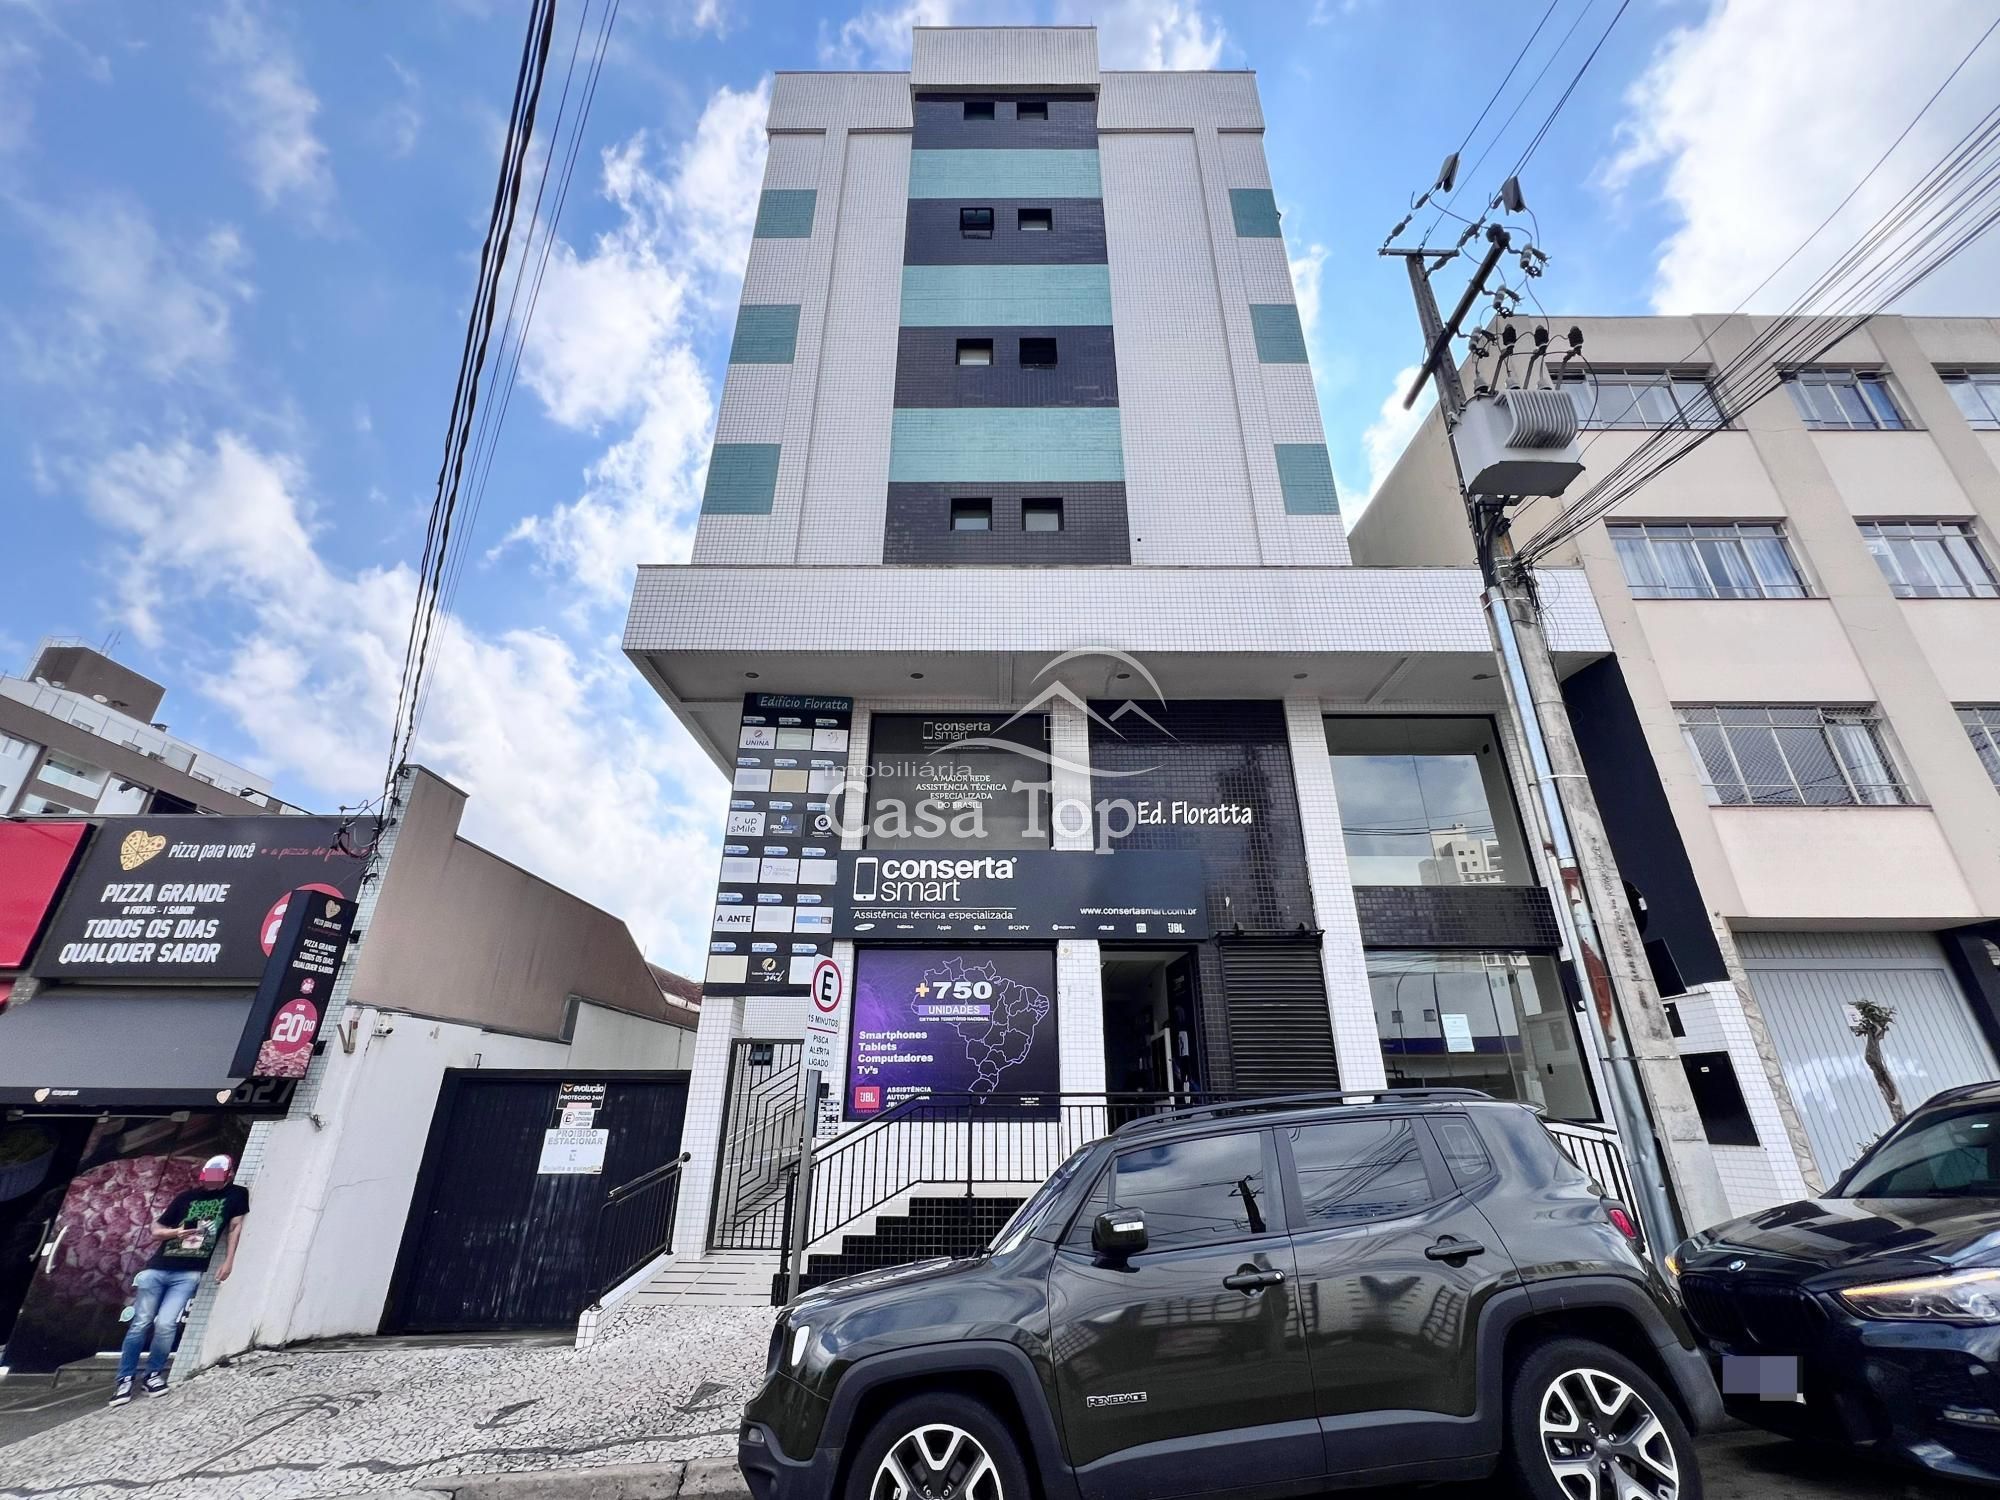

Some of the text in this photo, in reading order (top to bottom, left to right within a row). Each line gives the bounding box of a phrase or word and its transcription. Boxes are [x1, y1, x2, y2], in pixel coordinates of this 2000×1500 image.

[760, 695, 848, 710] Edifício Floratta
[934, 721, 991, 731] conserta
[934, 731, 968, 740] smart
[916, 781, 1007, 791] ASSISTÊNCIA TÉCNICA
[1137, 800, 1253, 824] Ed. Floratta
[198, 845, 226, 861] para
[881, 857, 1013, 879] conserta
[100, 883, 231, 902] PIZZA GRANDE
[880, 879, 961, 902] smart
[853, 910, 1013, 921] Assistência técnica especializada
[83, 919, 220, 939] TODOS OS DIAS
[1168, 923, 1186, 933] JBL
[58, 943, 222, 963] QUALQUER SABOR
[820, 971, 834, 1002] E
[928, 1006, 981, 1015] UNIDADES
[808, 1014, 839, 1028] 15 MINUTOS
[812, 1034, 829, 1044] PISCA
[859, 1031, 928, 1041] Smartphones
[809, 1045, 830, 1056] ALERTA
[858, 1043, 898, 1051] Tablets
[808, 1057, 829, 1067] LIGADO
[857, 1053, 934, 1063] Computadores
[857, 1065, 879, 1075] Tv's
[573, 1084, 604, 1093] evolução
[860, 1091, 876, 1103] JBL
[556, 1129, 598, 1138] PROIBIDO
[1087, 1392, 1148, 1408] RENEGADE
